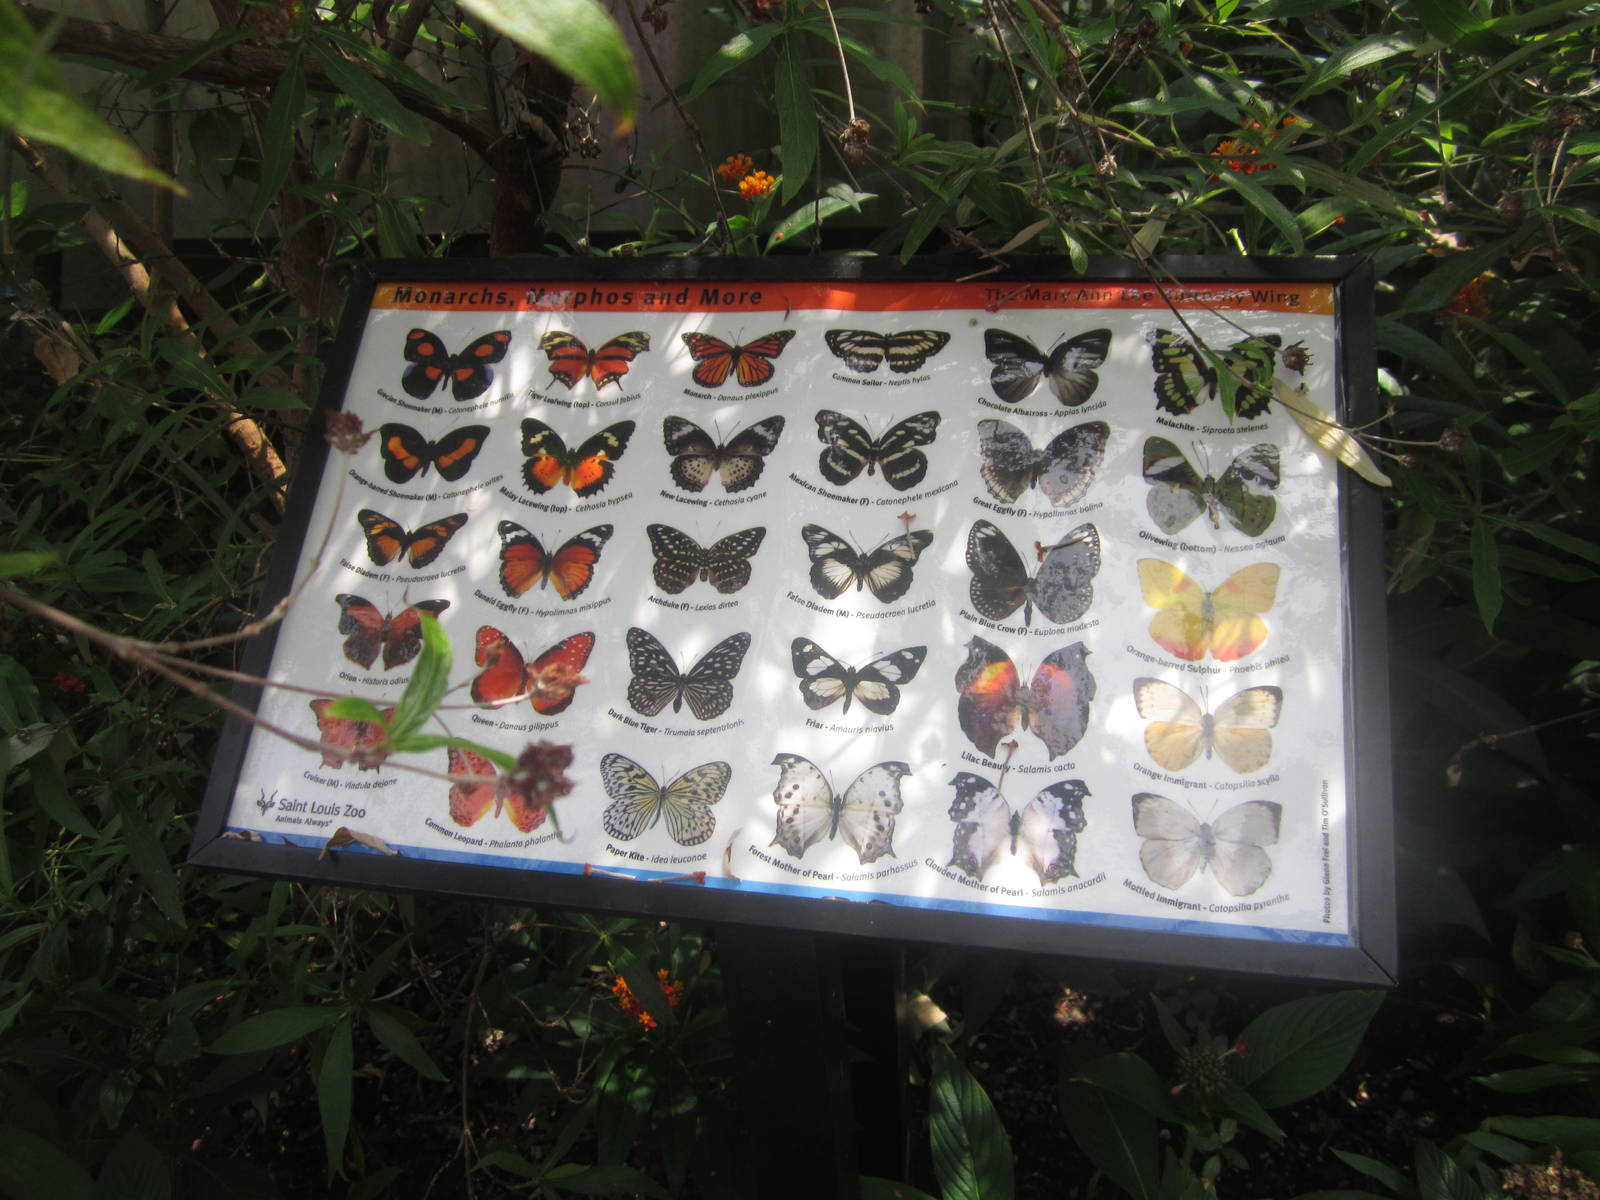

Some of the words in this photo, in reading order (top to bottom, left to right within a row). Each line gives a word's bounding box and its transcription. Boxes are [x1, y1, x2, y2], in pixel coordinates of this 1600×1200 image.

[394, 287, 514, 306] Monarchs,
[643, 288, 689, 305] and
[700, 288, 762, 305] More
[1025, 288, 1070, 303] Mary
[1077, 288, 1113, 301] Ann
[1250, 290, 1300, 307] Wing
[832, 372, 860, 385] Common
[862, 378, 882, 387] Sailor
[888, 378, 911, 387] Neptis
[912, 373, 931, 385] hylas
[528, 389, 544, 401] Tiger
[544, 395, 573, 408] Leafwing
[573, 400, 590, 409] (top)
[595, 398, 619, 408] Consul
[682, 387, 712, 400] Monarch
[717, 393, 743, 401] Danaus
[745, 387, 779, 400] plexippus
[397, 400, 431, 413] Shoemaker
[977, 396, 1012, 413] Chocolate
[1012, 407, 1048, 417] Albatross
[1054, 407, 1080, 418] Appias
[1081, 400, 1107, 415] lyncida
[1155, 416, 1195, 432] Malachite
[1201, 425, 1235, 435] Siproeta
[388, 489, 424, 501] Shoemaker
[500, 486, 518, 502] Malay
[518, 495, 549, 512] Lacewing
[550, 503, 568, 514] (top)
[575, 501, 606, 513] Cethosia
[607, 491, 633, 507] hypsea
[660, 489, 676, 501] New
[675, 495, 709, 508] Lacewing
[714, 496, 745, 506] Cethosia
[746, 491, 767, 504] cyane
[789, 472, 816, 493] Mexican
[817, 488, 859, 505] Shoemaker
[859, 497, 870, 507] (F)
[876, 493, 923, 507] Catonephele
[924, 479, 959, 499] mexicana
[973, 496, 993, 509] Great
[993, 503, 1016, 517] Eggfly
[1016, 508, 1027, 518] (F)
[1079, 501, 1103, 514] bolina
[1138, 529, 1178, 551] Olivewing
[1179, 541, 1217, 554] (bottom)
[339, 558, 356, 571] False
[355, 566, 378, 580] Diadem
[379, 573, 390, 583] (F)
[440, 564, 466, 577] lucretia
[474, 589, 496, 606] Danaid
[496, 600, 517, 614] Eggfly
[517, 605, 529, 616] (F)
[535, 606, 577, 617] Hypolimnas
[579, 596, 612, 611] misippus
[648, 594, 680, 609] Archduke
[680, 601, 690, 611] (F)
[695, 602, 717, 611] Lexias
[718, 599, 739, 609] dirtea
[786, 590, 806, 606] False
[806, 599, 834, 615] Diadem
[835, 608, 849, 619] (M)
[855, 609, 906, 620] Pseudacraea
[907, 600, 936, 615] lucretia
[959, 609, 978, 623] Plain
[978, 617, 996, 630] Blue
[996, 623, 1017, 635] Crow
[1017, 626, 1028, 636] (F)
[1067, 618, 1099, 633] modesta
[1127, 645, 1186, 671] Orange-barred
[1187, 663, 1221, 676] Sulphur
[1229, 662, 1263, 673] Phoebis
[1264, 654, 1290, 669] philea
[339, 671, 357, 682] Orion
[389, 675, 409, 686] odius
[471, 713, 494, 727] Queen
[499, 720, 527, 732] Danaus
[528, 720, 560, 733] gilippus
[607, 707, 623, 722] Dark
[623, 715, 639, 728] Blue
[640, 721, 658, 735] Tiger
[664, 727, 695, 737] Tirumala
[696, 718, 745, 736] septentrionis
[806, 718, 824, 730] Friar
[830, 723, 864, 735] Amauris
[865, 723, 894, 735] niavius
[961, 750, 980, 764] Lilac
[1018, 763, 1052, 774] Salamis
[1054, 761, 1076, 772] cacta
[303, 770, 327, 785] Cruiser
[327, 778, 339, 788] (M)
[1133, 762, 1162, 781] Orange
[1163, 773, 1208, 790] Immigrant
[1214, 779, 1256, 792] Catopsilia
[1257, 773, 1280, 787] scylla
[278, 798, 307, 813] Saint
[311, 800, 341, 816] Louis
[343, 803, 366, 819] Zoo
[275, 815, 303, 825] Animals
[424, 817, 453, 838] Common
[453, 832, 484, 847] Leopard
[488, 837, 523, 849] Phalanta
[1322, 832, 1330, 847] and
[605, 843, 629, 858] Paper
[629, 850, 645, 861] Kite
[650, 853, 669, 863] Idea
[670, 852, 707, 864] leuconoe
[749, 844, 771, 864] Forest
[771, 857, 801, 876] Mother
[802, 867, 811, 878] of
[812, 870, 834, 881] Pearl
[840, 871, 875, 882] Salamis
[876, 858, 918, 879] parhassus
[924, 858, 956, 881] Clouded
[957, 874, 988, 892] Mother
[989, 885, 1000, 895] of
[1000, 887, 1024, 897] Pearl
[1031, 886, 1066, 898] Salamis
[1067, 871, 1106, 893] anacardii
[1122, 877, 1155, 900] Mottled
[1156, 893, 1201, 911] Immigrant
[1208, 900, 1251, 914] Catopsilia
[1253, 893, 1290, 911] pyranthe
[1322, 886, 1332, 896] by
[1322, 897, 1331, 923] Photos
